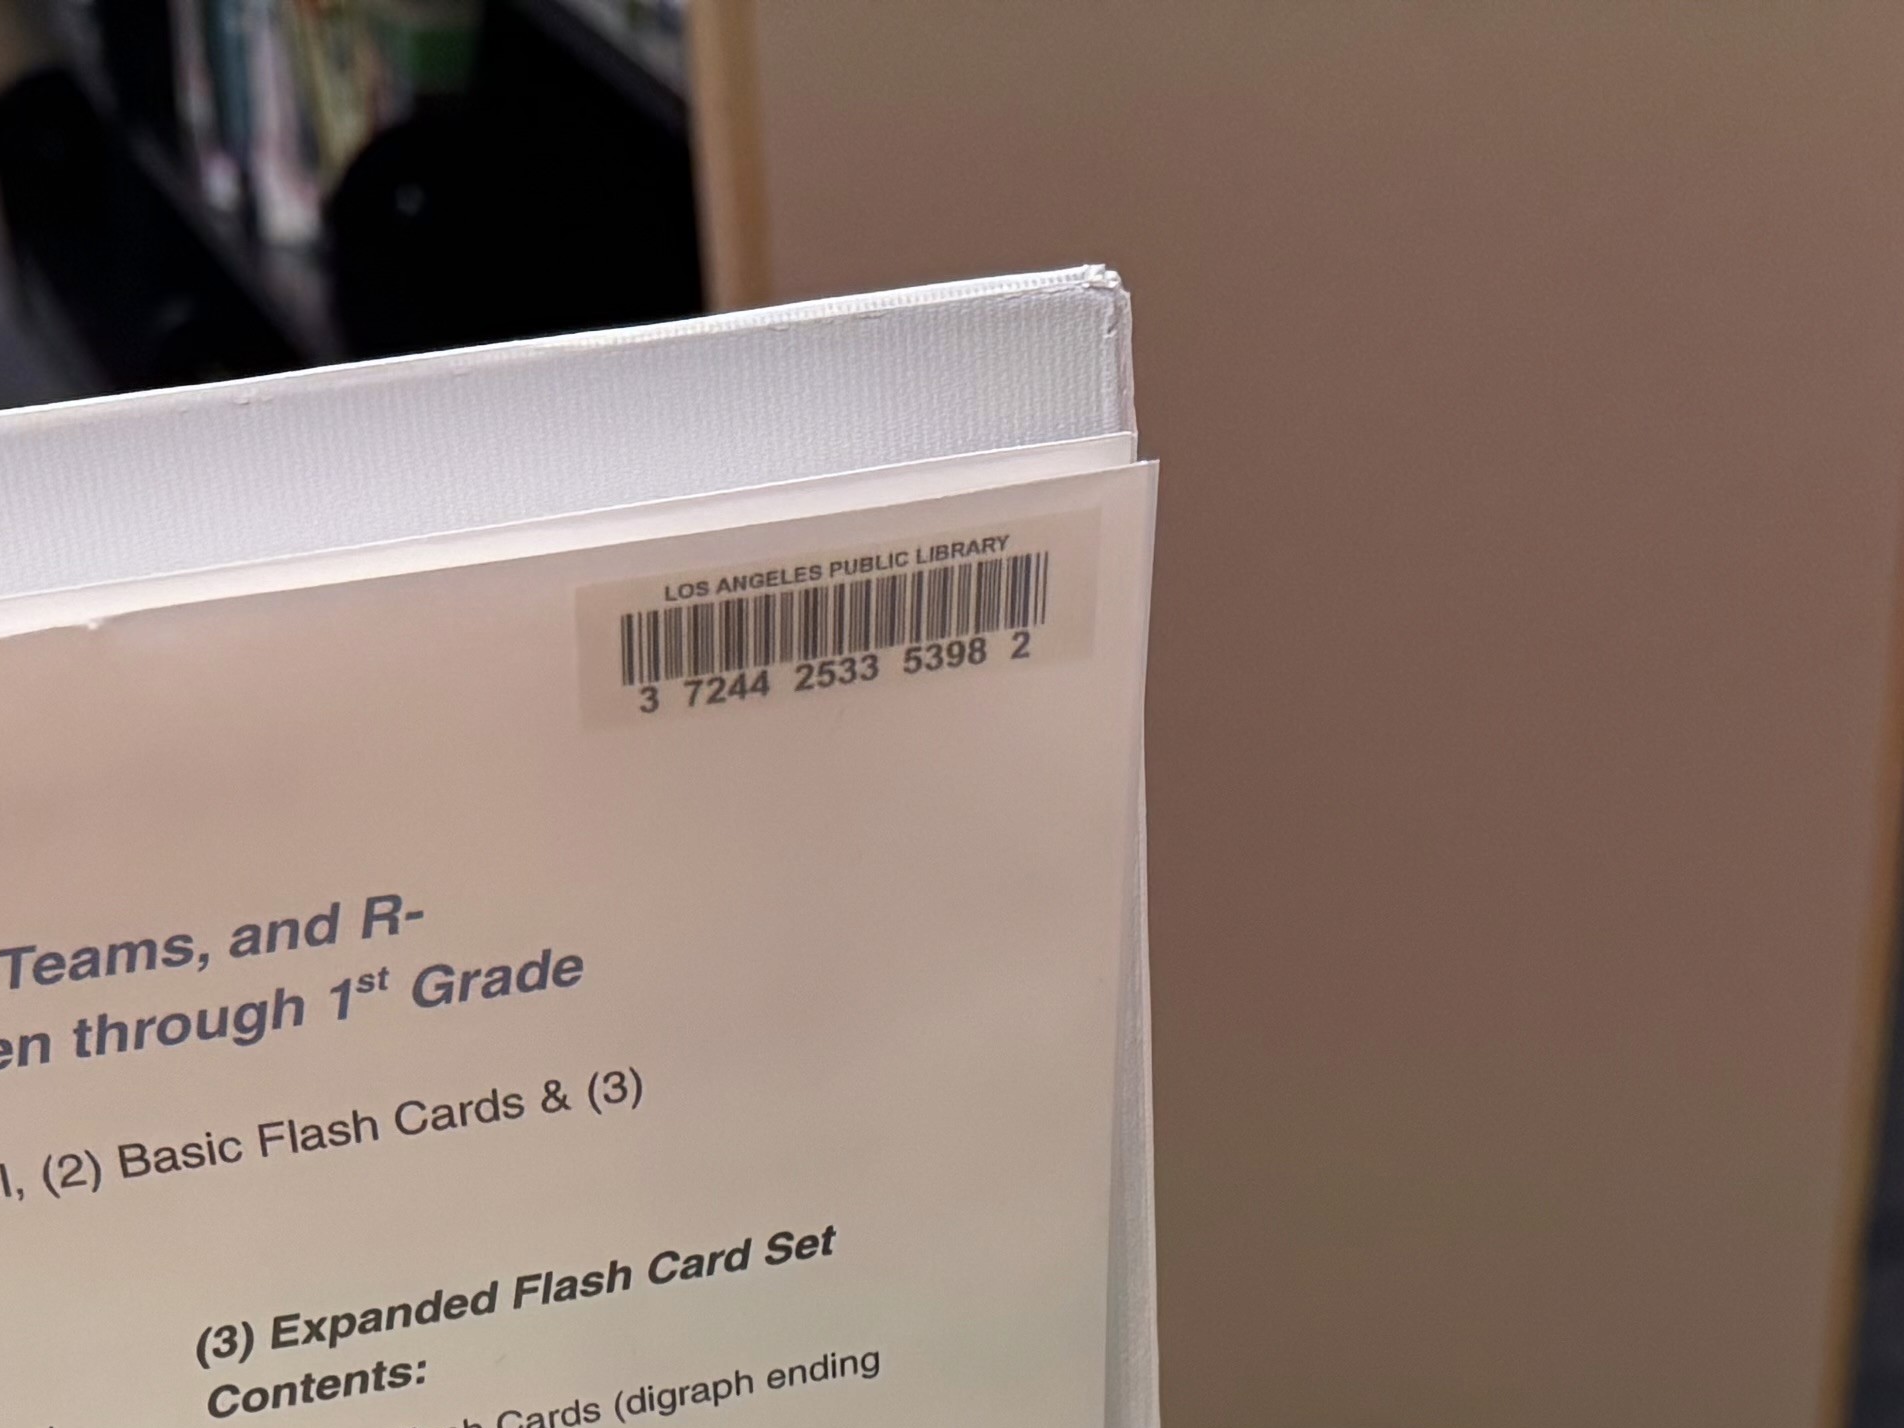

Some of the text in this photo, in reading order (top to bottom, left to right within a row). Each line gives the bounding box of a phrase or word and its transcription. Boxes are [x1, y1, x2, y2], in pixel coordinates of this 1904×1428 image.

[663, 533, 1011, 603] LOS ANGELES PUBLIC LIBRARY
[638, 631, 1032, 715] 3 7244 2533 5398 2
[228, 900, 342, 960] and
[360, 892, 425, 941] R-
[71, 986, 306, 1059] through
[410, 947, 585, 1010] Grade
[41, 1148, 103, 1200] (2)
[116, 1130, 244, 1180] Basic
[256, 1108, 380, 1159] Flash
[393, 1087, 526, 1137] Cards
[539, 1078, 573, 1115] &
[586, 1066, 644, 1116] (3)
[195, 1224, 838, 1371] (3) Expanded Flash Card Set
[206, 1358, 428, 1420] Contents:
